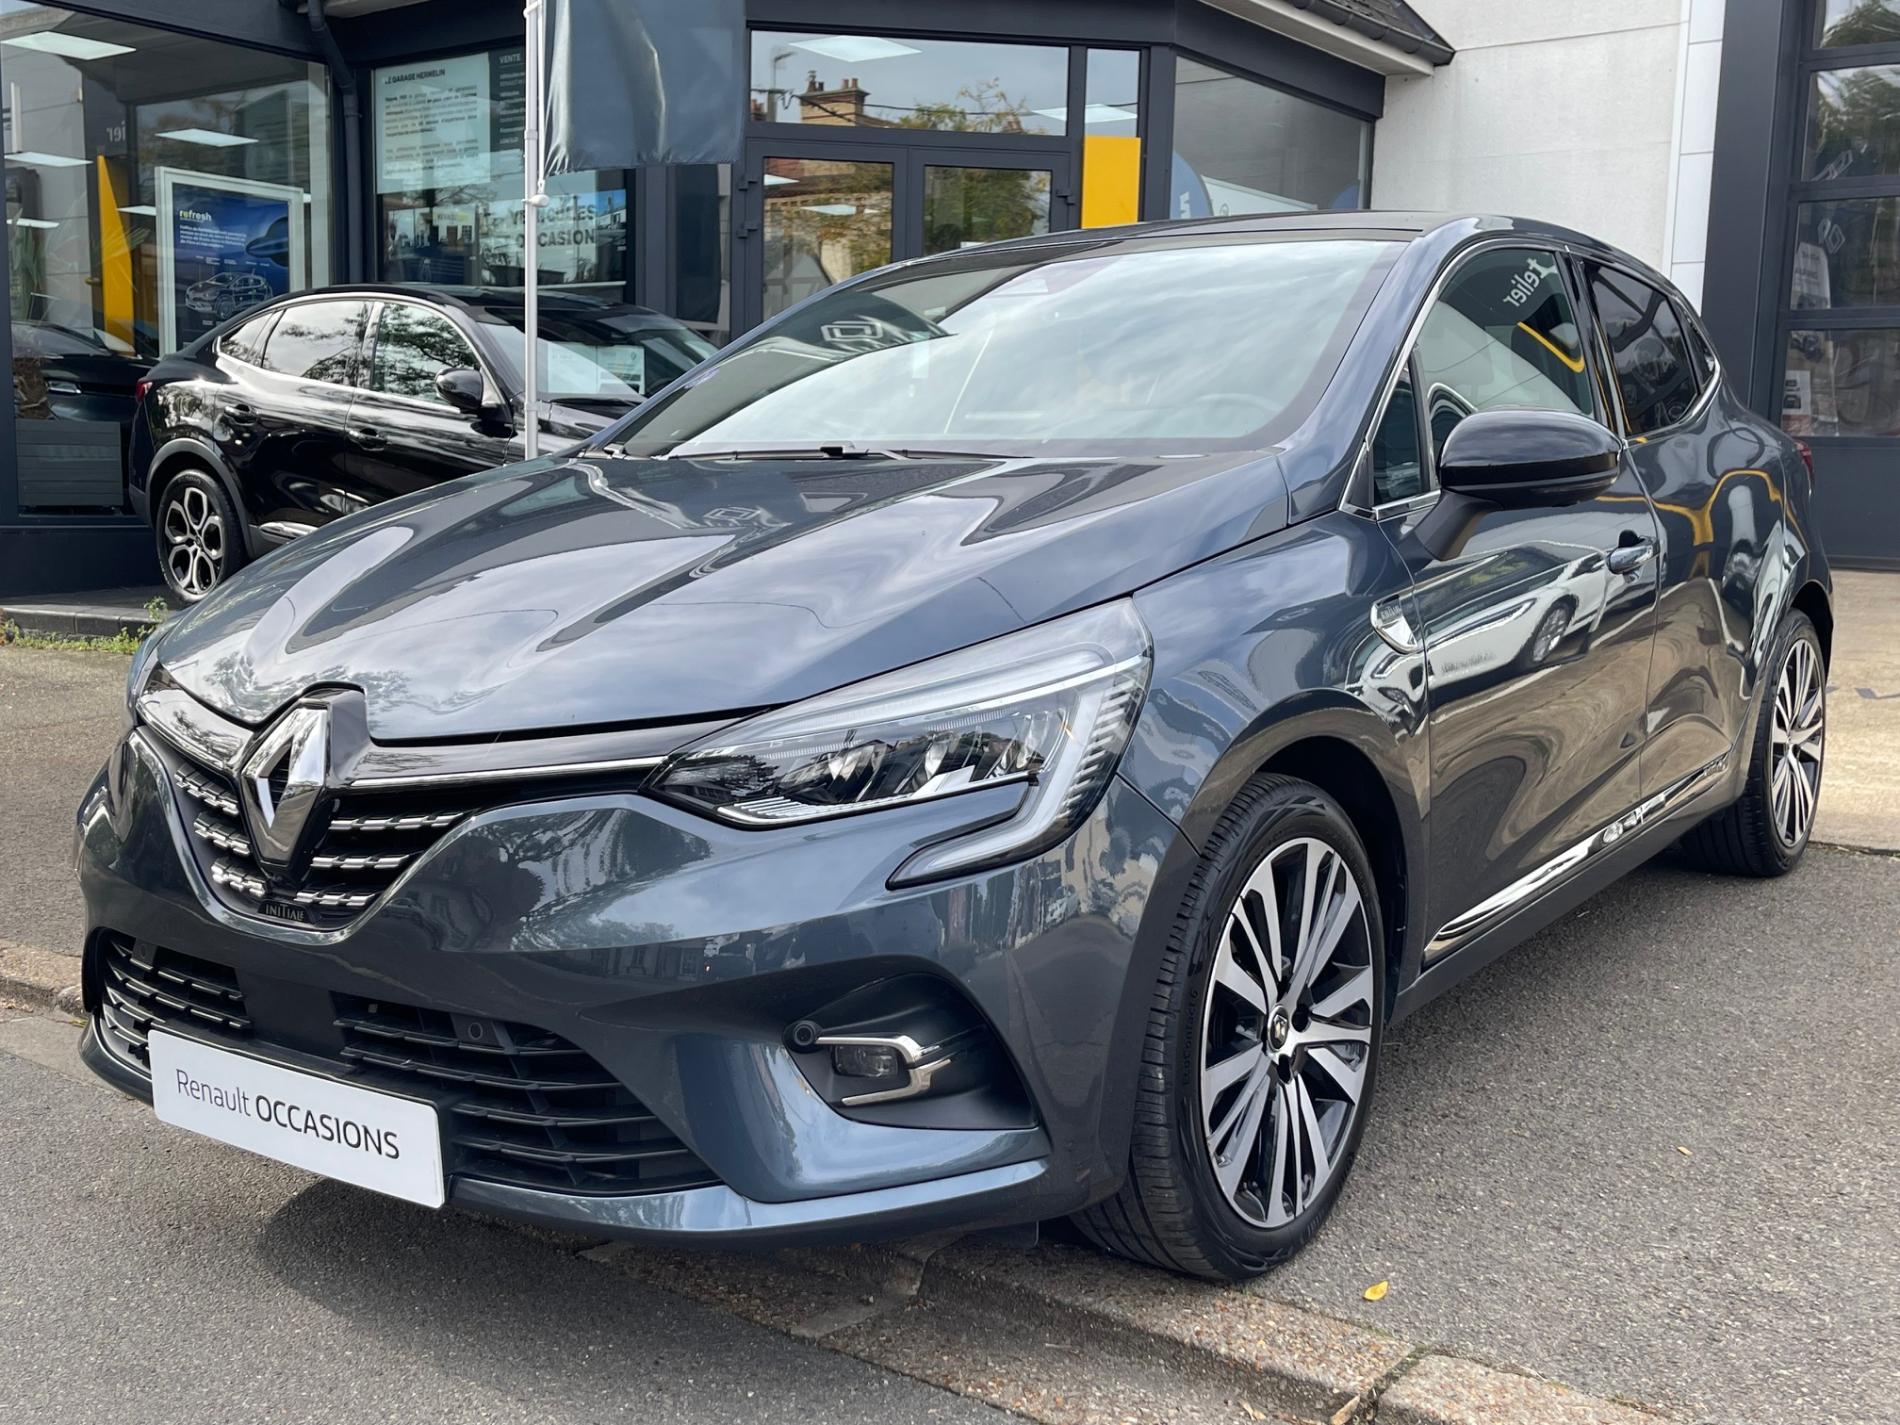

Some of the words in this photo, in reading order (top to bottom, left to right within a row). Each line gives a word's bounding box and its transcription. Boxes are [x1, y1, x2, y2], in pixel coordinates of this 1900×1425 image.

[499, 53, 521, 63] VENTE
[393, 73, 416, 83] GARAGE
[179, 209, 212, 222] refresh
[516, 228, 596, 248] OCASION
[265, 903, 305, 922] INITIALE
[175, 1068, 251, 1117] Renault
[255, 1094, 400, 1160] OCCASIONS
